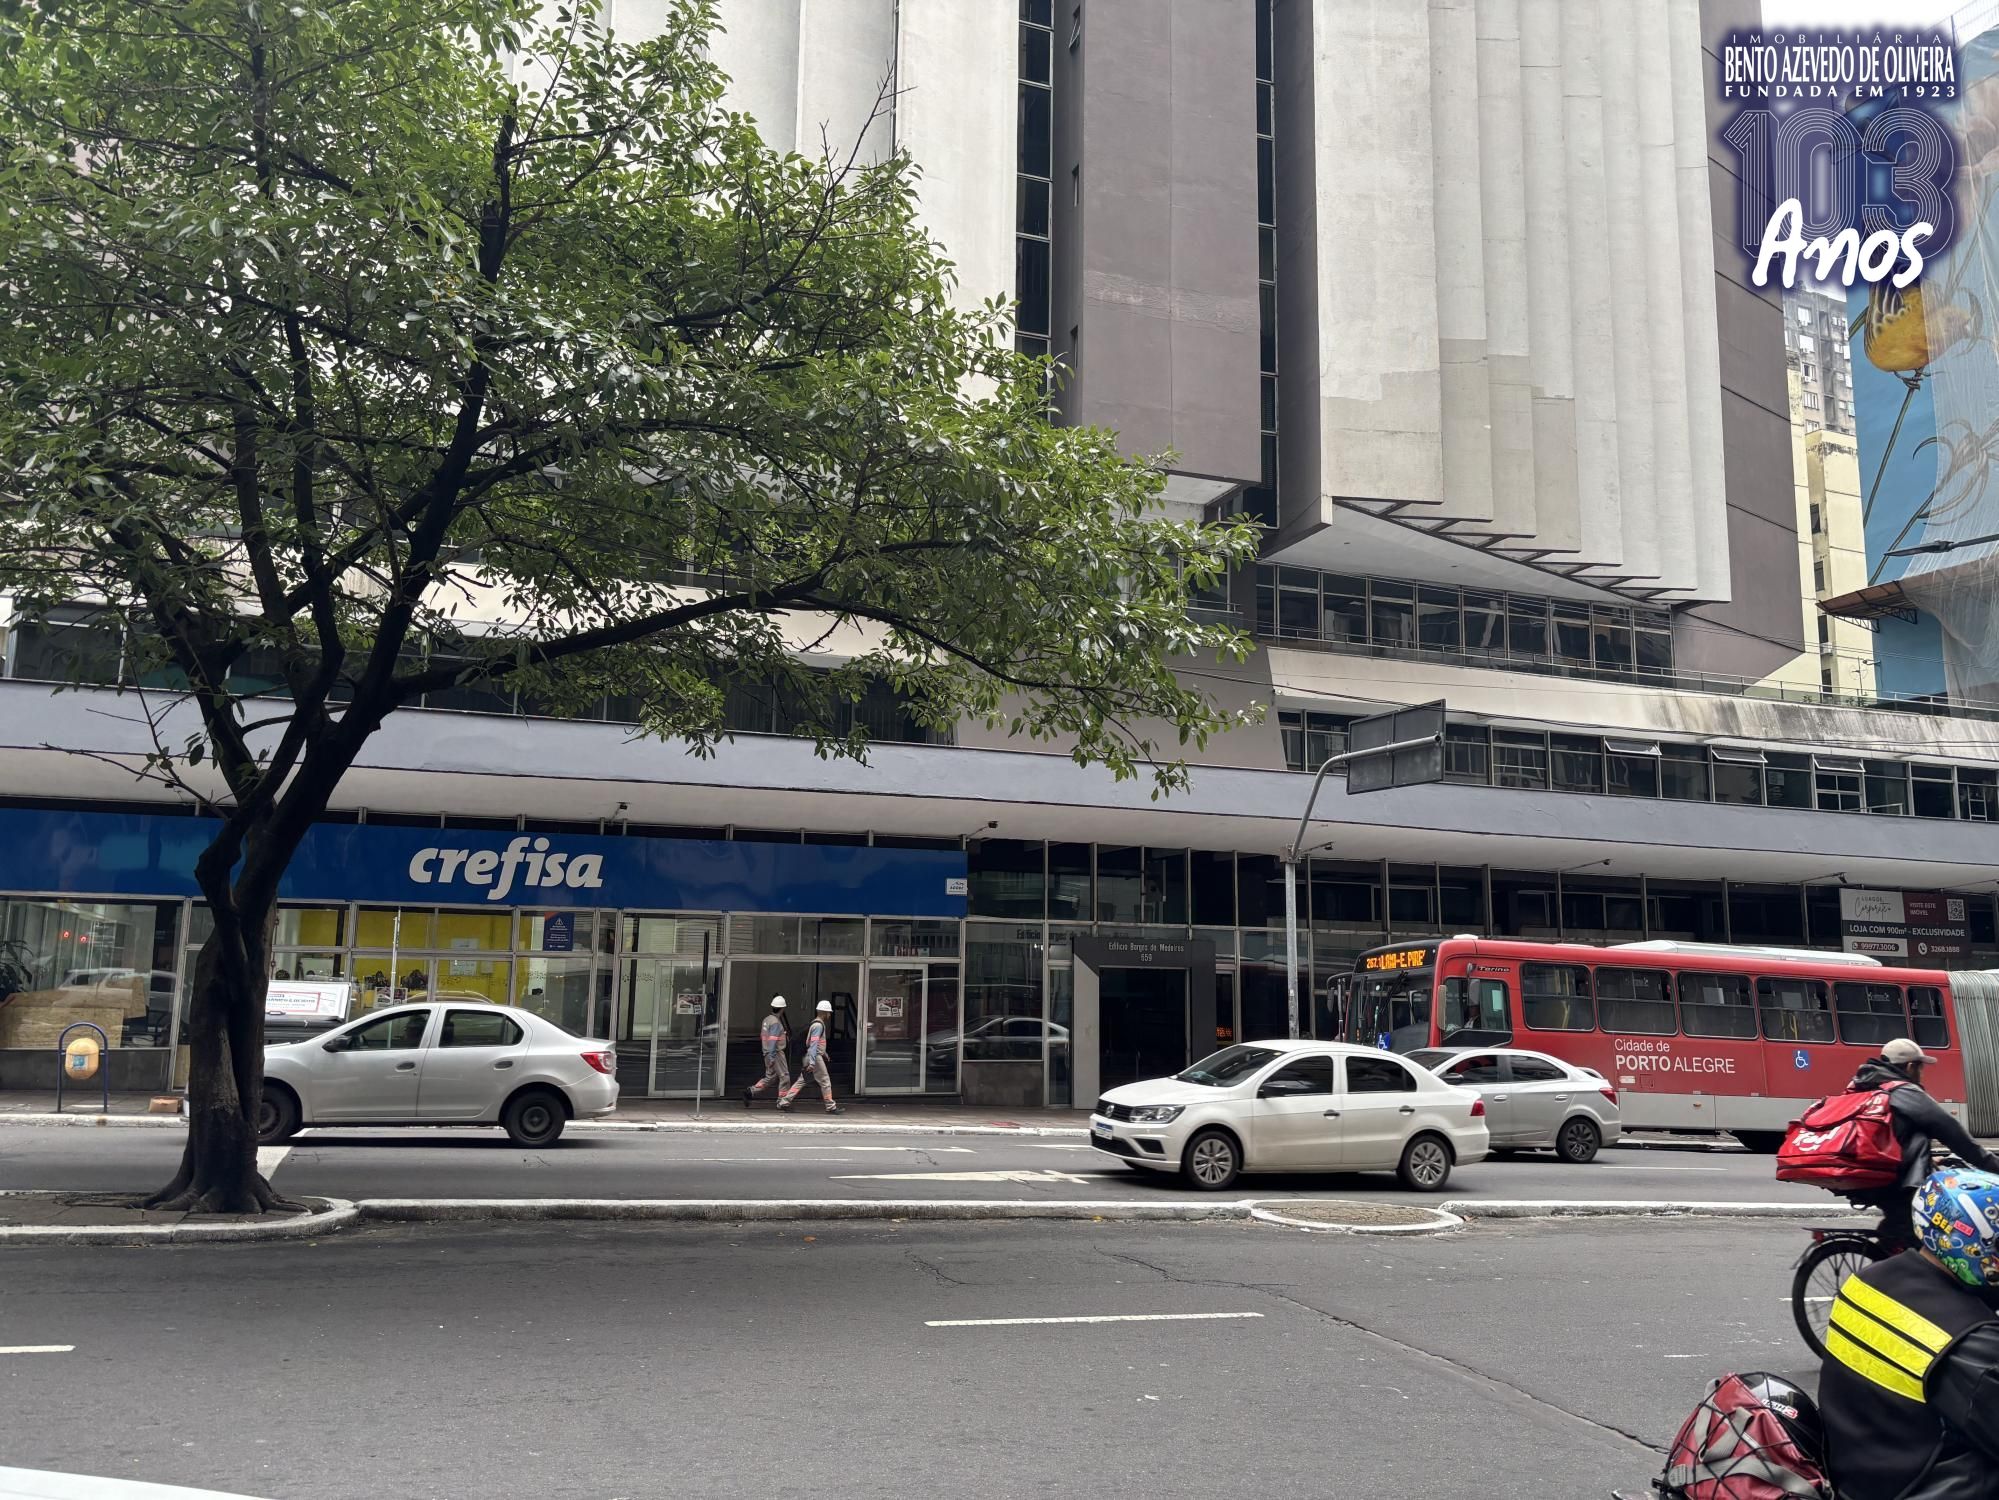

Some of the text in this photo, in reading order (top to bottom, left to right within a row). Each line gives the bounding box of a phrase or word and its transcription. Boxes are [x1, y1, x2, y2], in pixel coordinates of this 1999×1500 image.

[408, 836, 604, 901] crefisa
[1849, 924, 1868, 933] LOJA
[1868, 925, 1886, 934] COM
[1912, 927, 1965, 937] EXCLUSIVIDADE
[1614, 1038, 1670, 1053] Cidade de
[1615, 1054, 1736, 1074] PORTO ALEGRE
